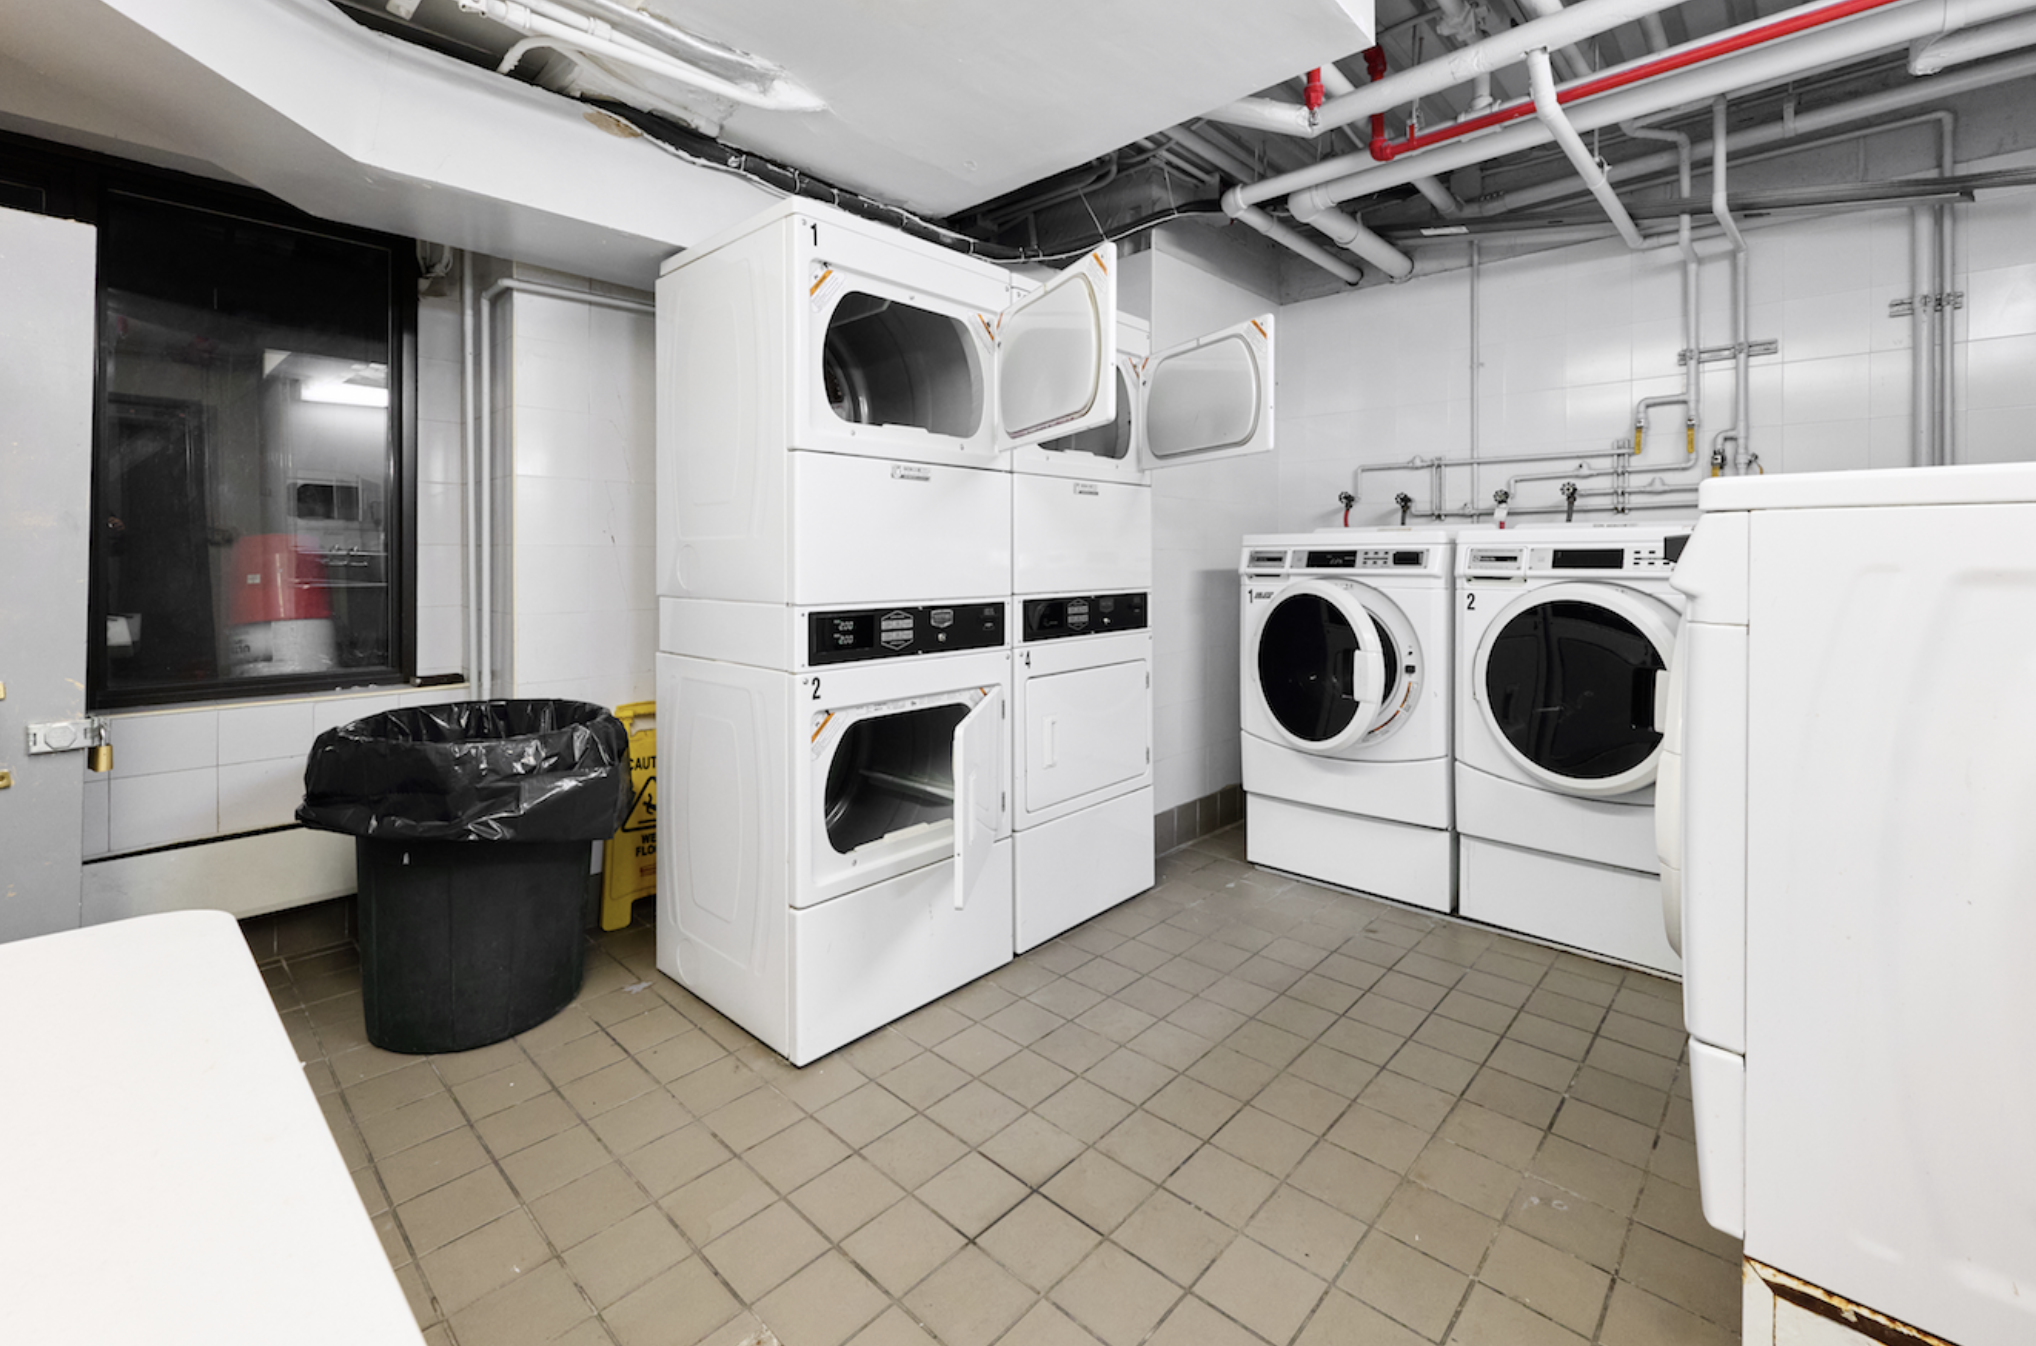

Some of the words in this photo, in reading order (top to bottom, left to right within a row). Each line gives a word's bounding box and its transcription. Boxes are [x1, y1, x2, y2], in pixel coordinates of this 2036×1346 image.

[810, 222, 817, 246] 1
[1248, 588, 1253, 604] 1
[1467, 593, 1476, 611] 2
[1025, 649, 1032, 669] 4
[811, 676, 821, 701] 2
[635, 845, 656, 857] FLO
